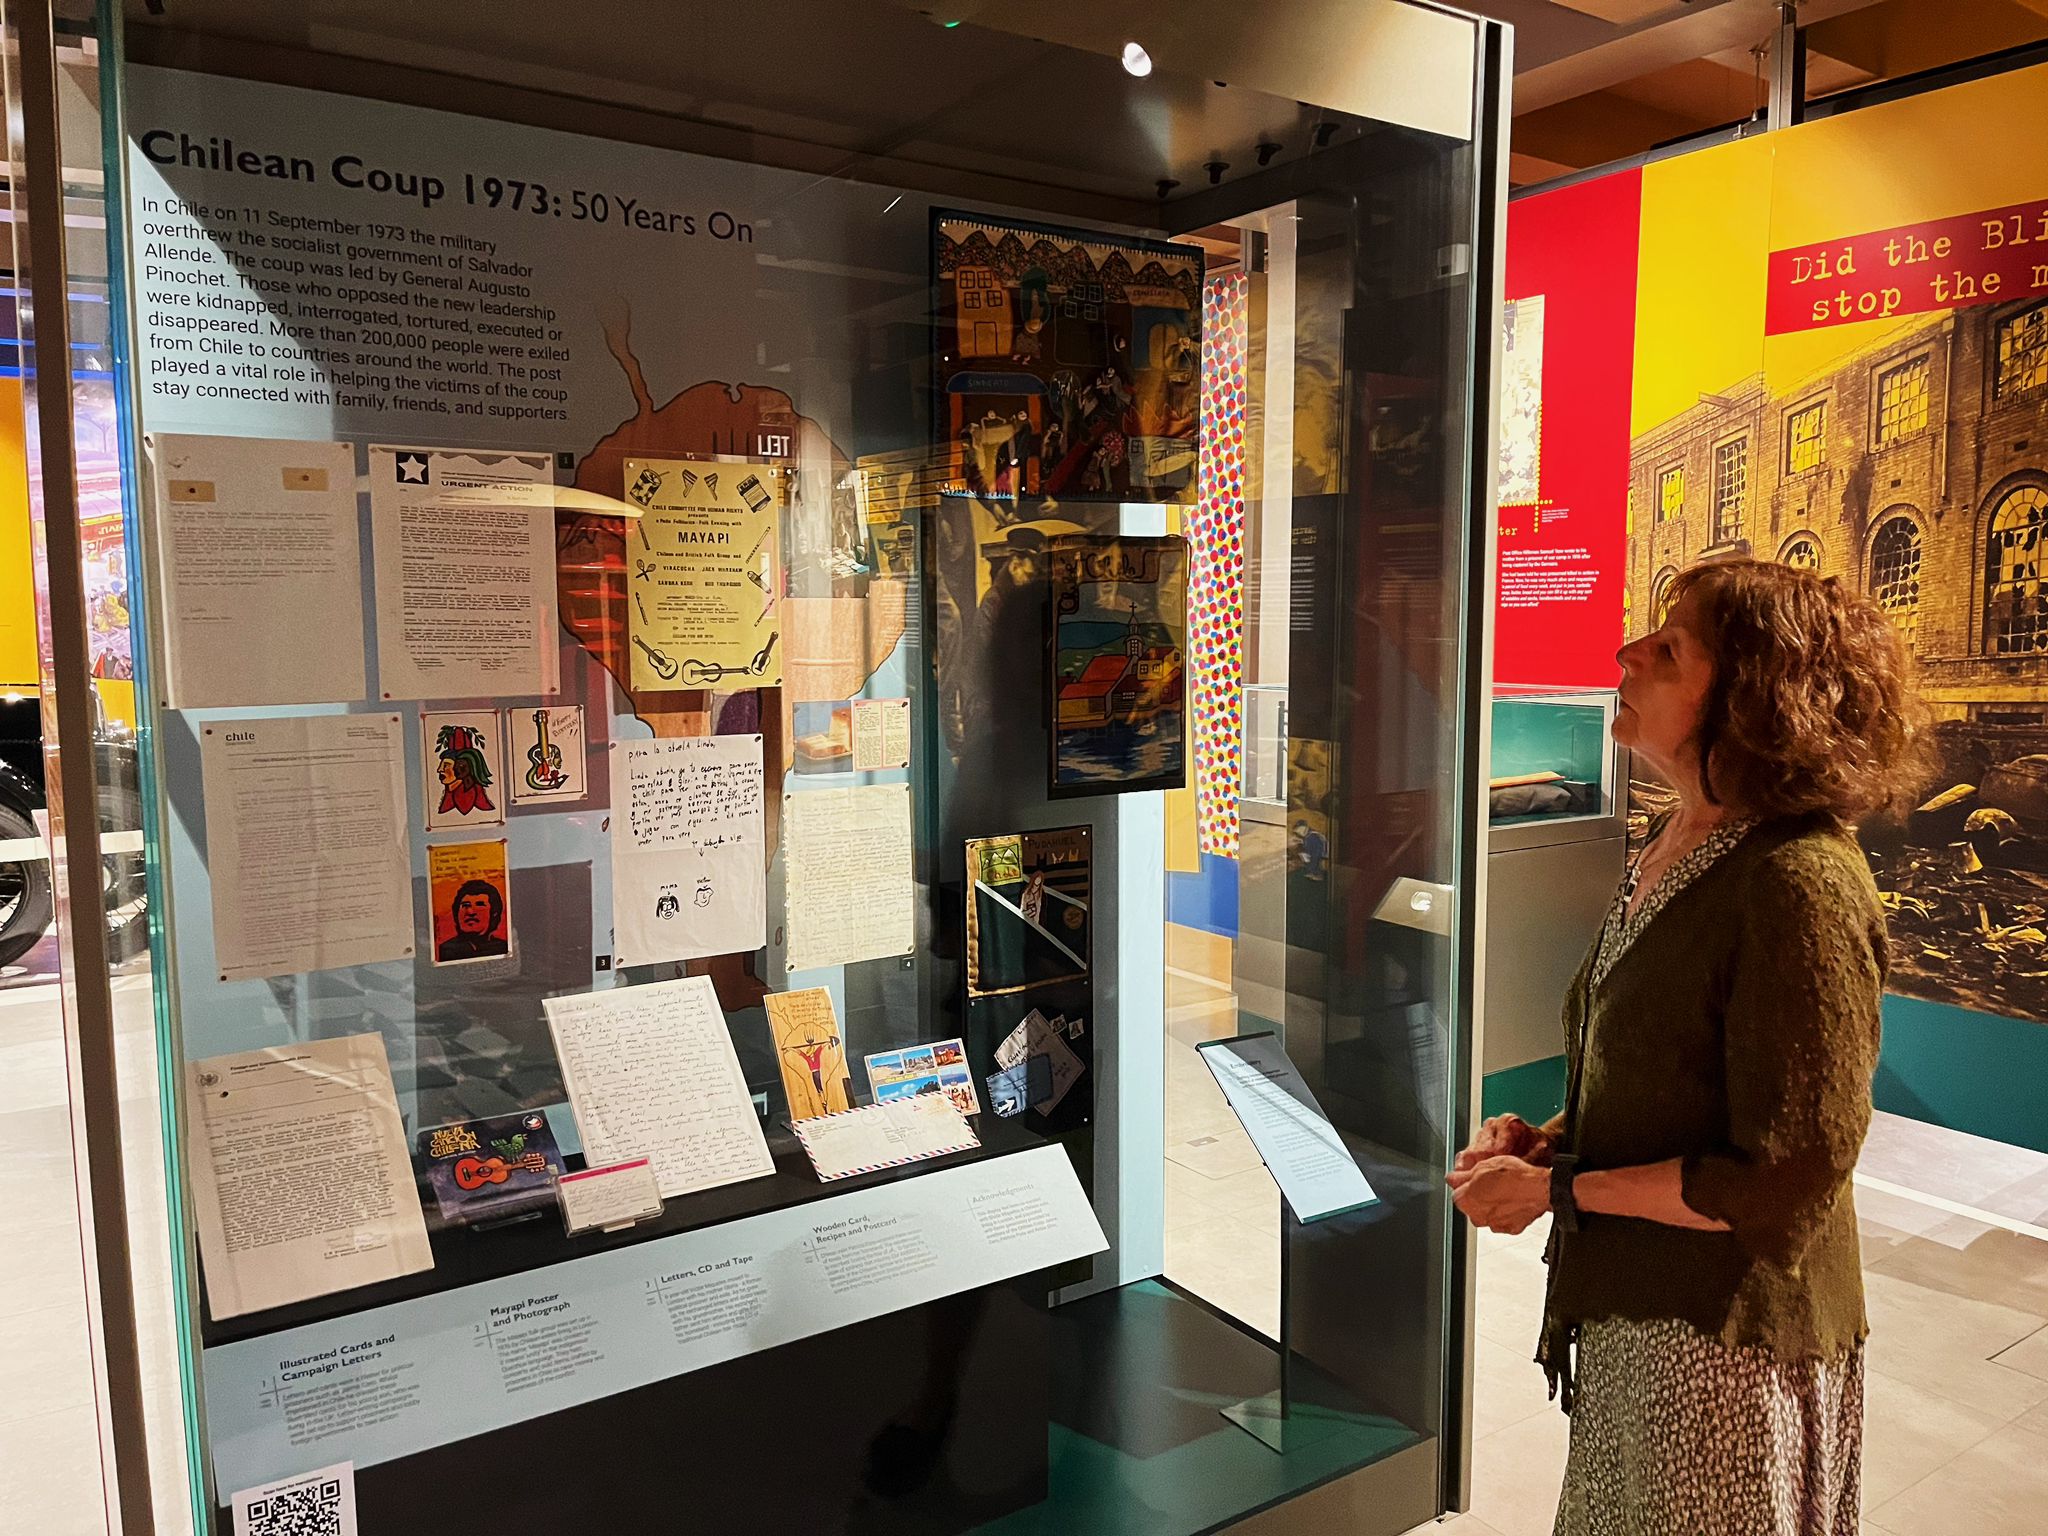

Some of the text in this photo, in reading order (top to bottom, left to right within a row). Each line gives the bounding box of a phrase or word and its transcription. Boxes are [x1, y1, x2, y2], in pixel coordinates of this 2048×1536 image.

[141, 130, 752, 243] Chilean Coup 1973: 50 Years On
[143, 197, 496, 256] In Chile on 11 September 1973 the military
[144, 224, 533, 277] overthrew the socialist government of Salvador
[145, 243, 530, 297] Allende. The coup was led by General Augusto
[1790, 246, 1856, 284] Did
[1883, 234, 1952, 267] the
[147, 266, 556, 323] Pinochet. Those who opposed the new leadership
[1812, 286, 1902, 322] stop
[1930, 271, 2001, 303] the
[147, 292, 562, 341] were kidnapped, interrogated, tortured, executed or
[149, 311, 569, 361] disappeared. More than 200,000 people were exiled
[150, 333, 561, 381] from Chile to countries around the world. The post
[152, 357, 567, 403] played a vital role in helping the victims of the coup
[153, 381, 567, 420] stay connected with family, friends, and supporters
[441, 480, 488, 489] URGENT
[678, 532, 729, 544] MAYAPI
[225, 731, 255, 742] chile
[973, 1184, 1034, 1203] Acknowledgments
[812, 1215, 870, 1234] Wooden Card,
[816, 1217, 897, 1244] Recipes and Postcard
[661, 1256, 752, 1283] Letters, CD and Tape
[490, 1294, 558, 1316] Mayapi Poster
[493, 1302, 570, 1327] and Photograph
[280, 1334, 395, 1370] Illustrated Cards and
[282, 1352, 381, 1381] Campaign Letters
